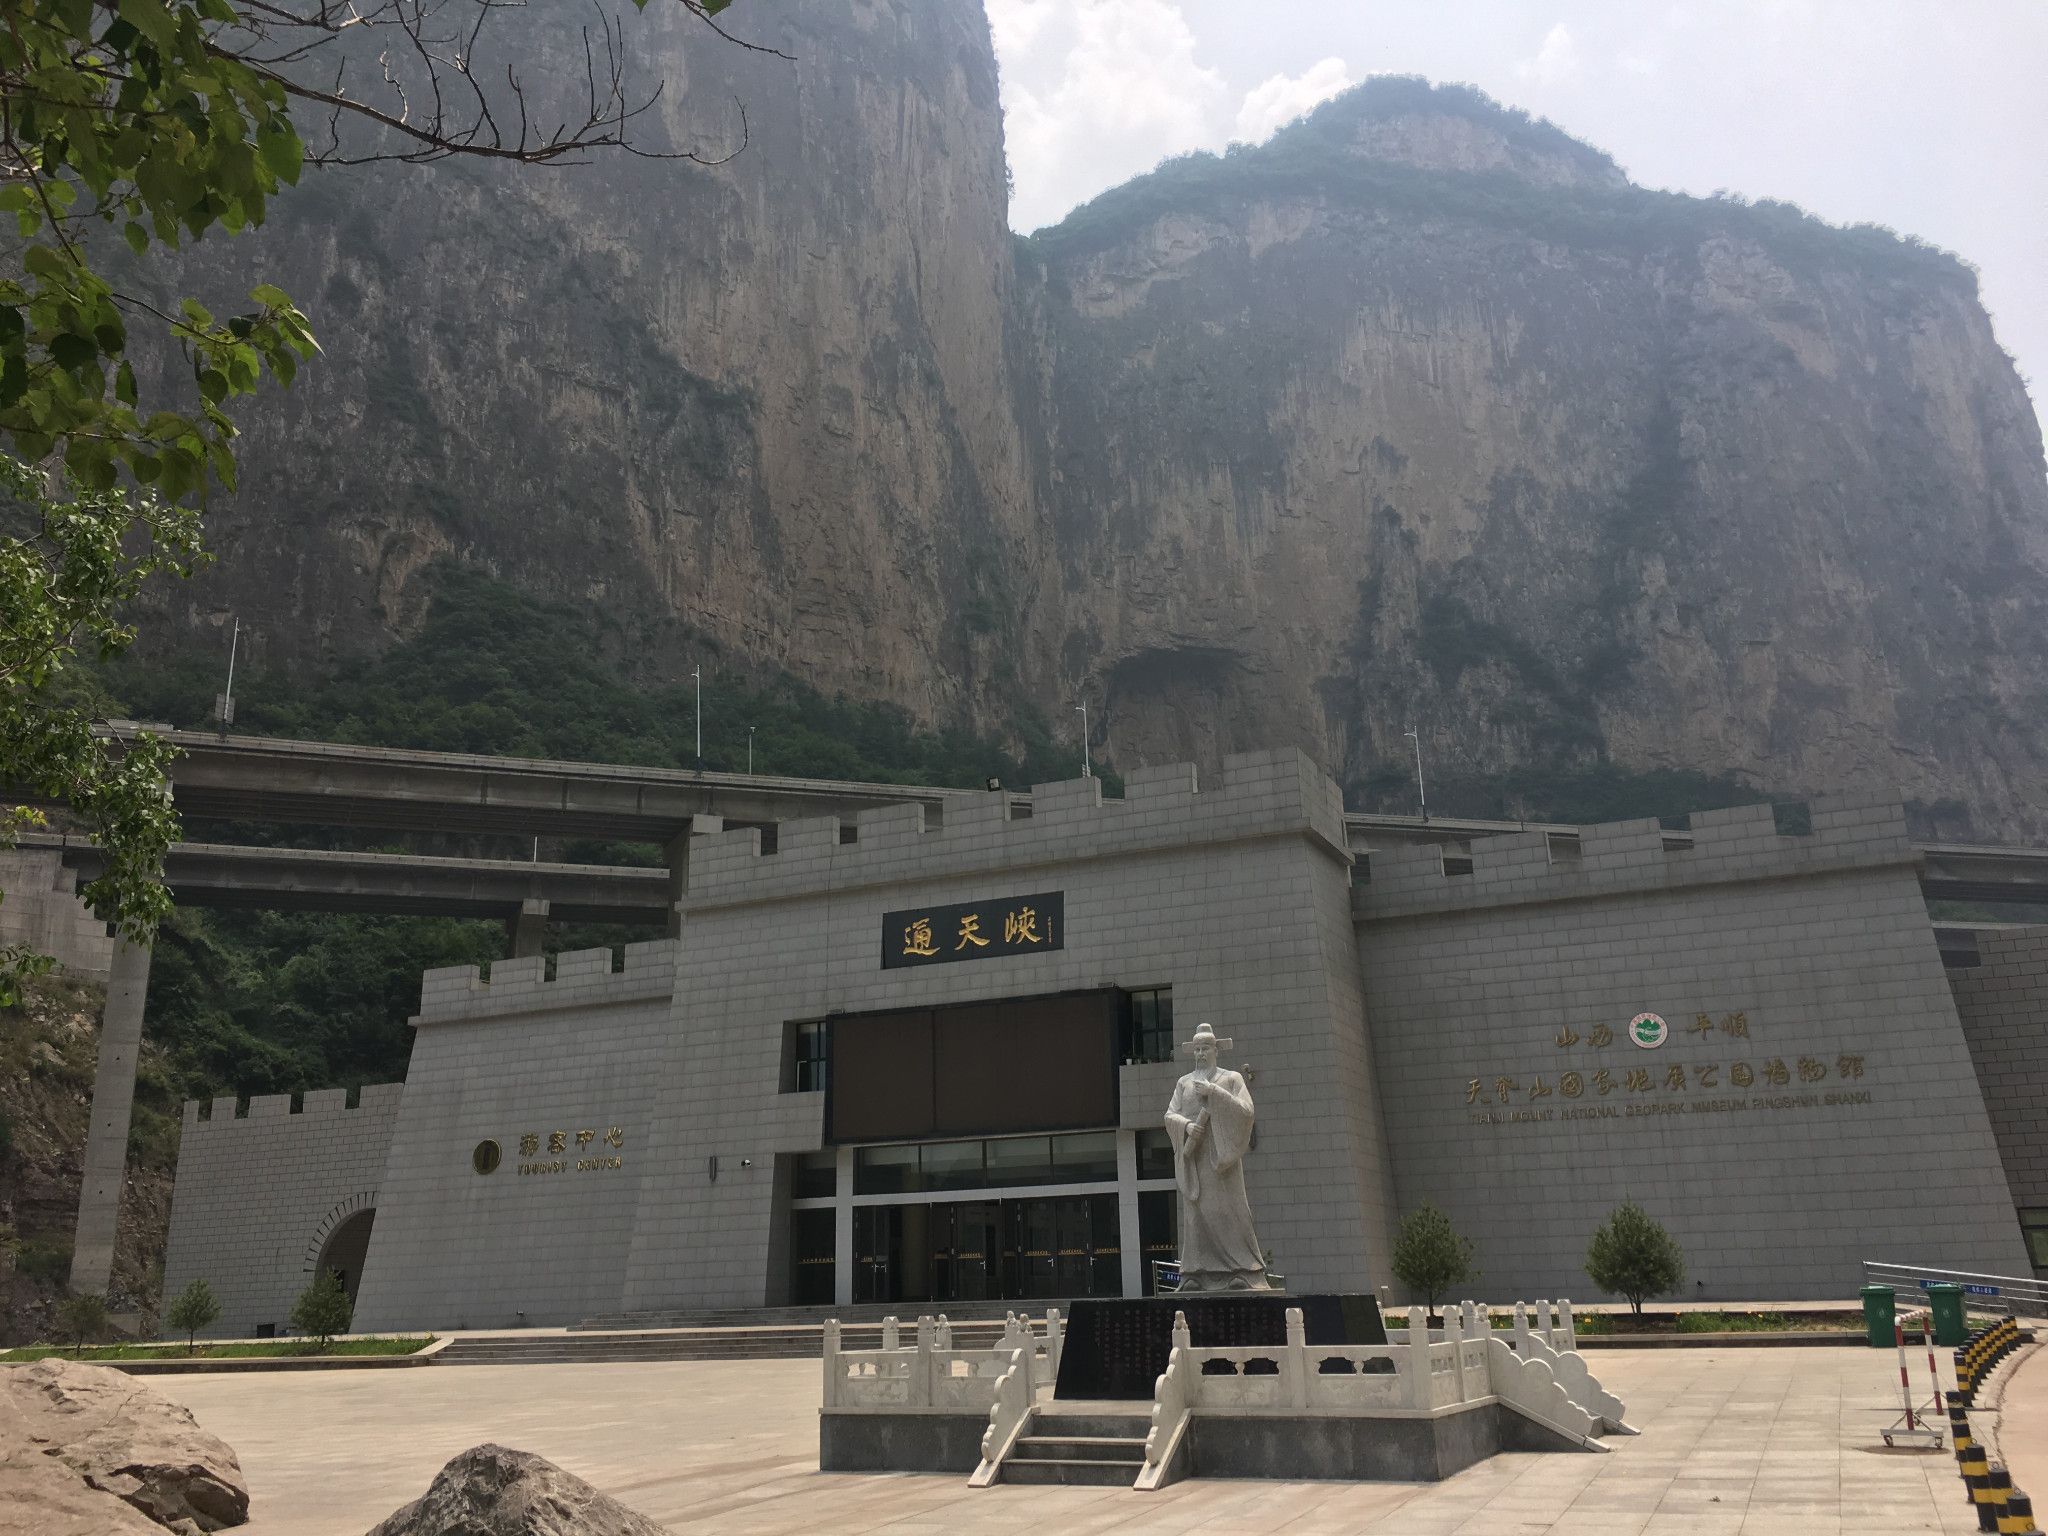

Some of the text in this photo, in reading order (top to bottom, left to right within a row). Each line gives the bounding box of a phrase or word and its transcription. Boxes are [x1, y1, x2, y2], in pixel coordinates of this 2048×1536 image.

[1560, 1105, 1619, 1120] NATIONAL
[1624, 1102, 1686, 1117] GEOPARK
[1824, 1091, 1872, 1106] SHANXI
